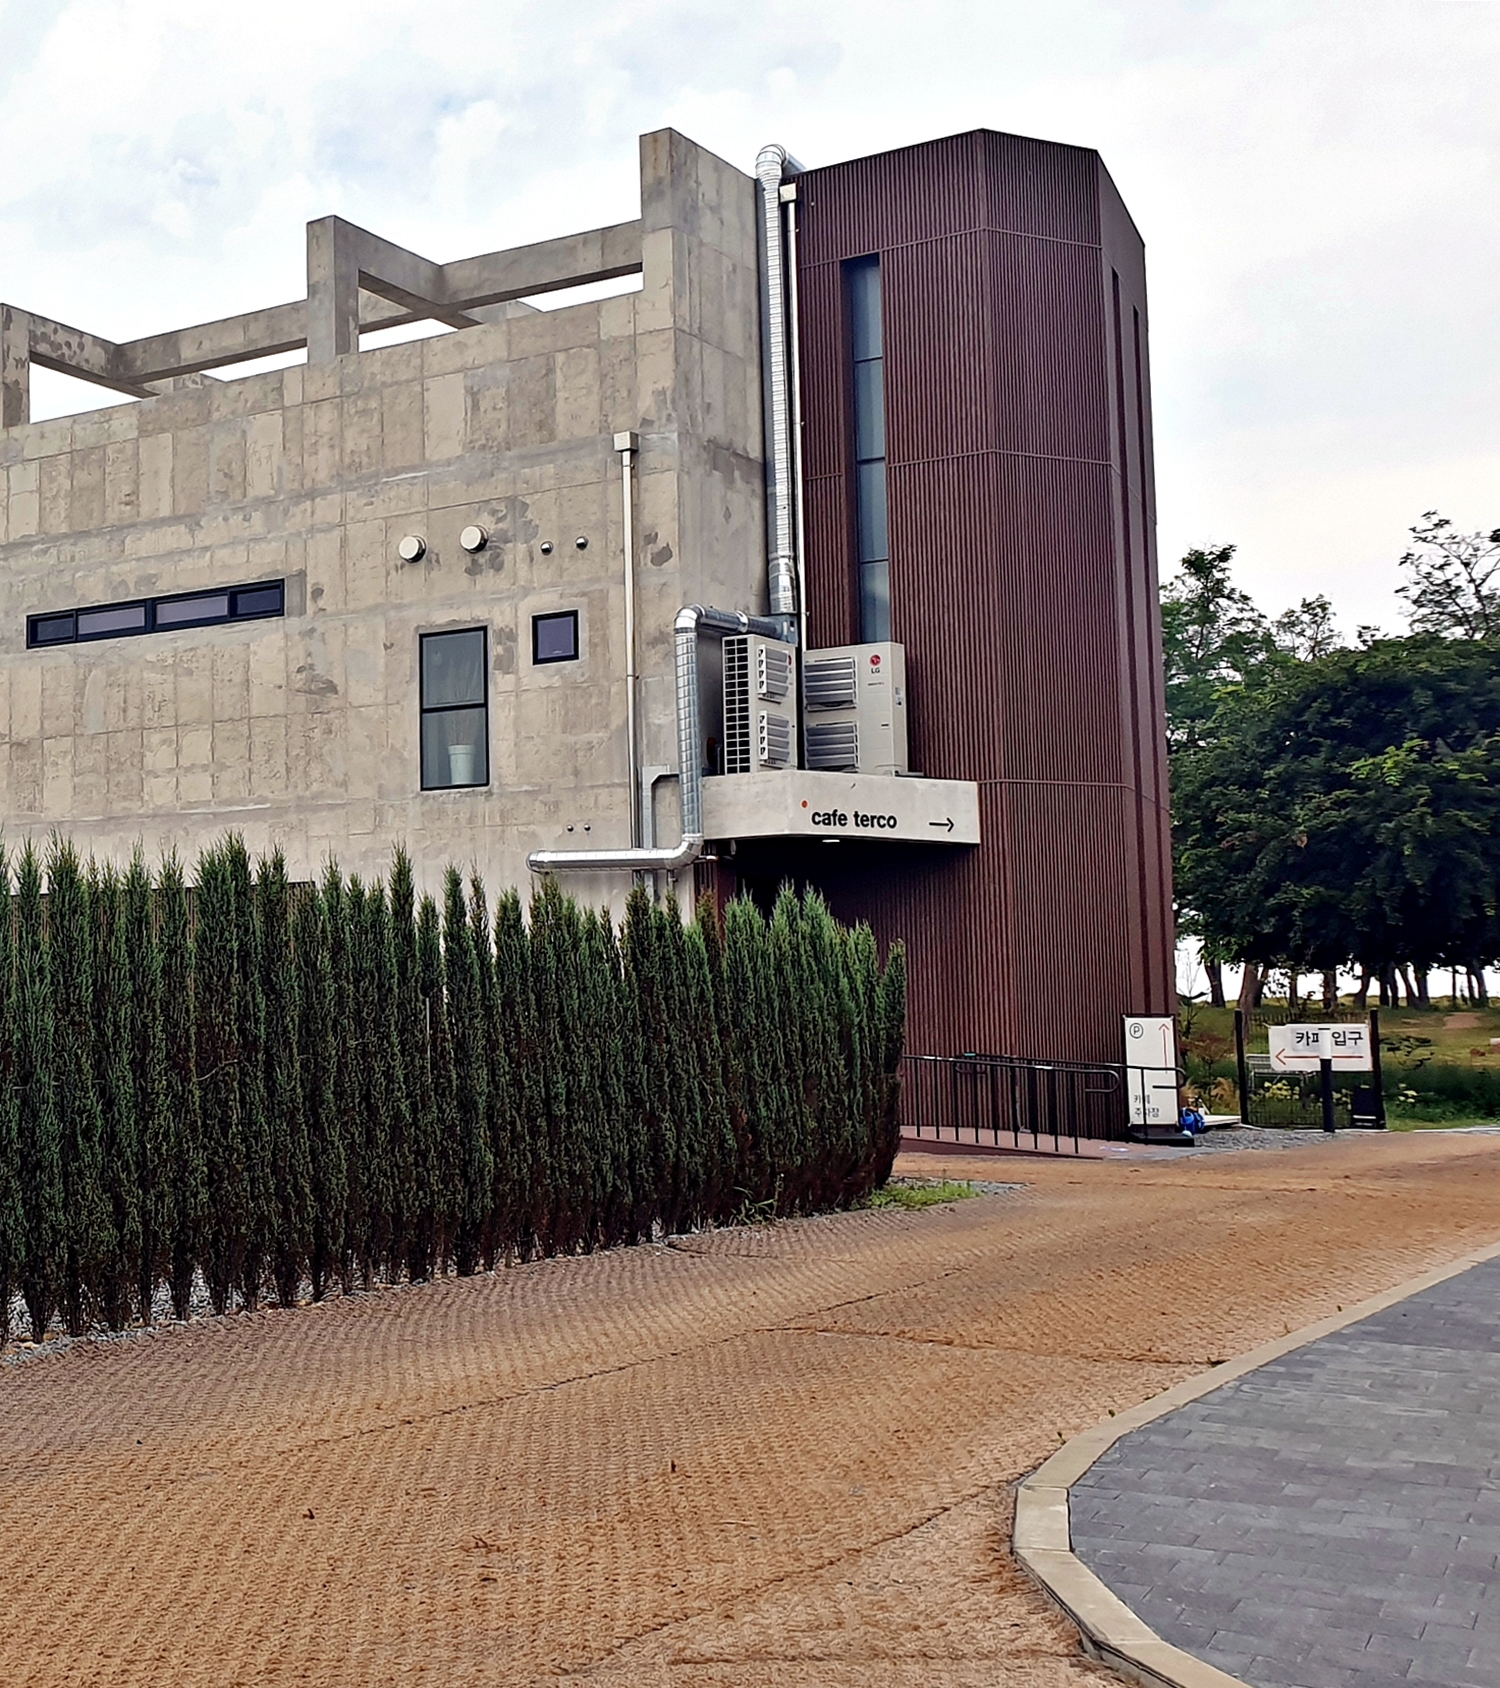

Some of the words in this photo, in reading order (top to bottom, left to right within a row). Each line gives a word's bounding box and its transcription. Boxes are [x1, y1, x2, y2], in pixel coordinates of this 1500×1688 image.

[811, 808, 848, 828] cafe
[853, 810, 898, 830] terco
[1331, 1030, 1364, 1046] 입구
